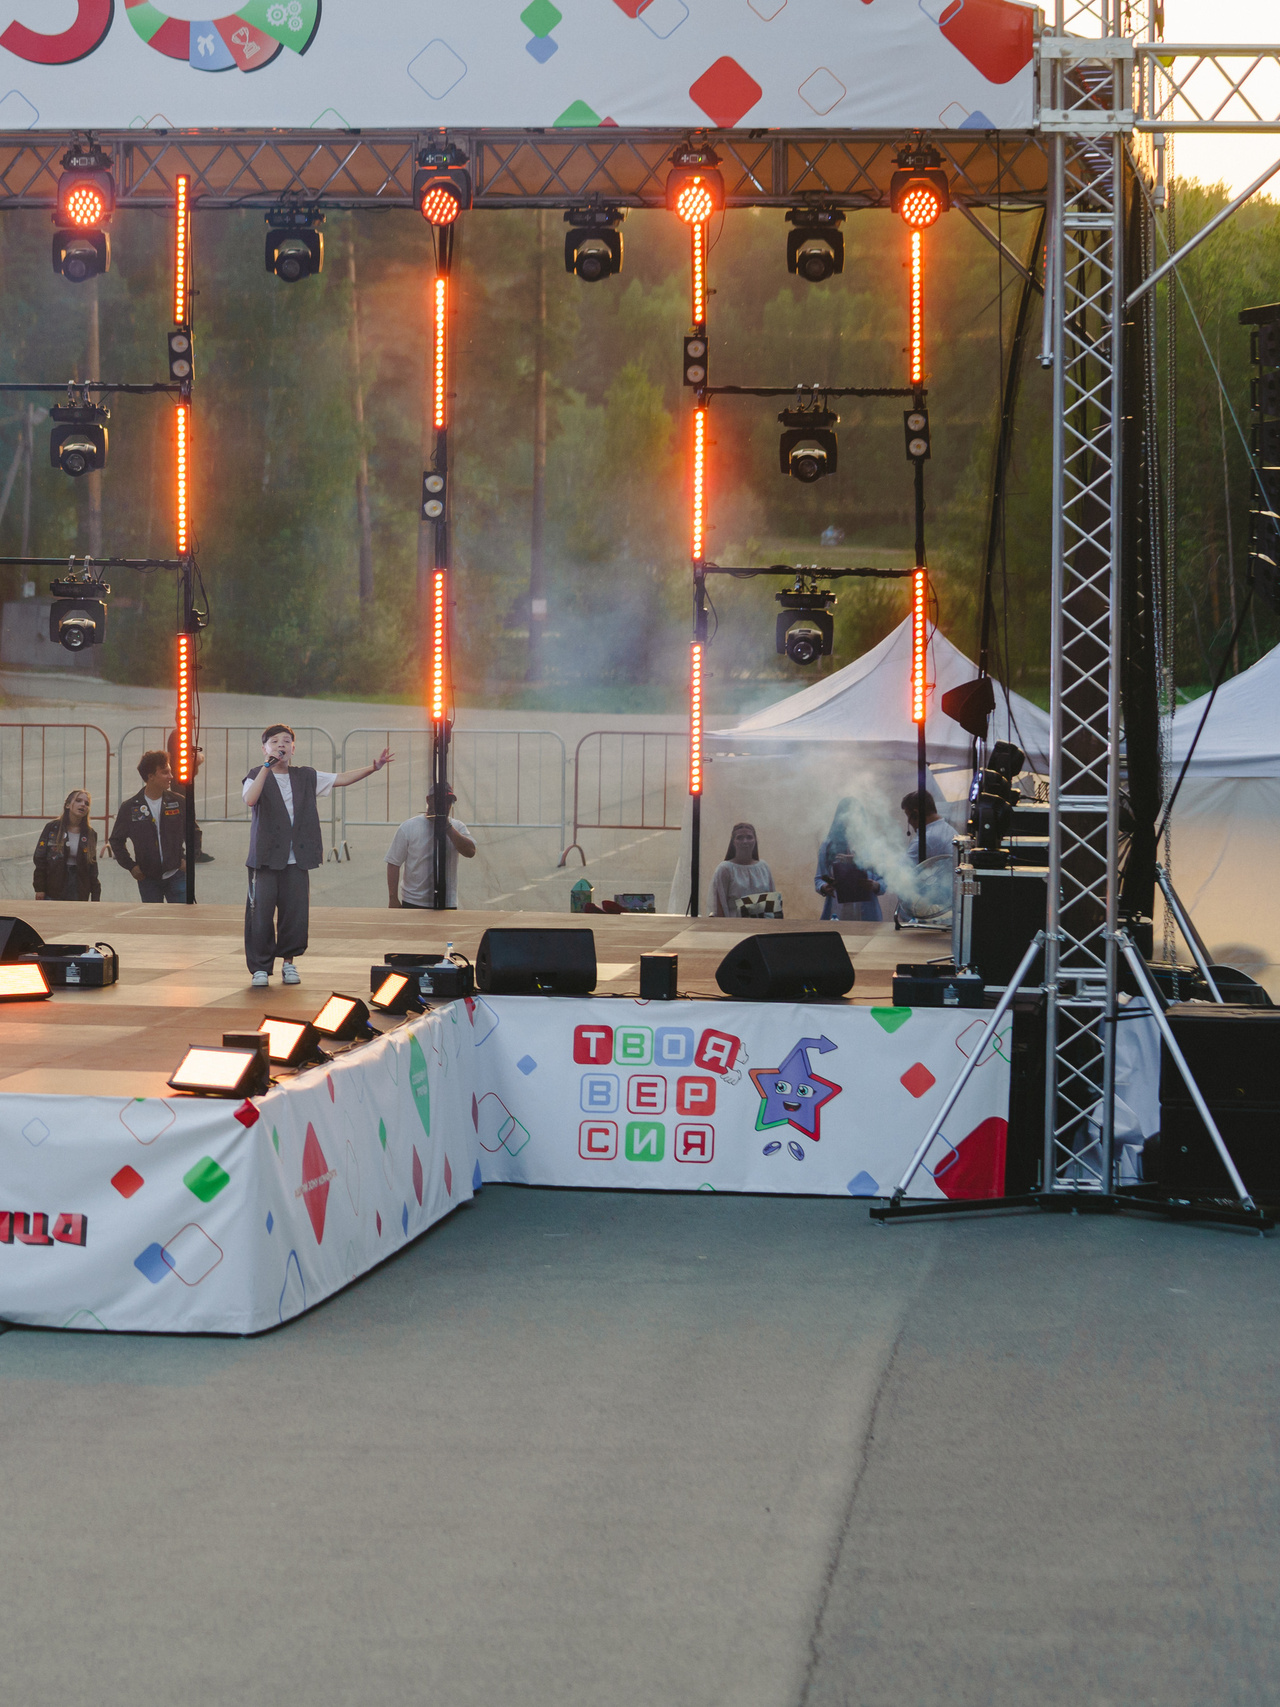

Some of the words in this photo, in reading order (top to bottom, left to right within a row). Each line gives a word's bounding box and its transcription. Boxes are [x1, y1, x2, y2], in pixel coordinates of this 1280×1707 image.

[580, 1031, 734, 1068] ТВОЯ
[587, 1079, 710, 1111] ВЕР
[586, 1126, 707, 1157] СИЯ
